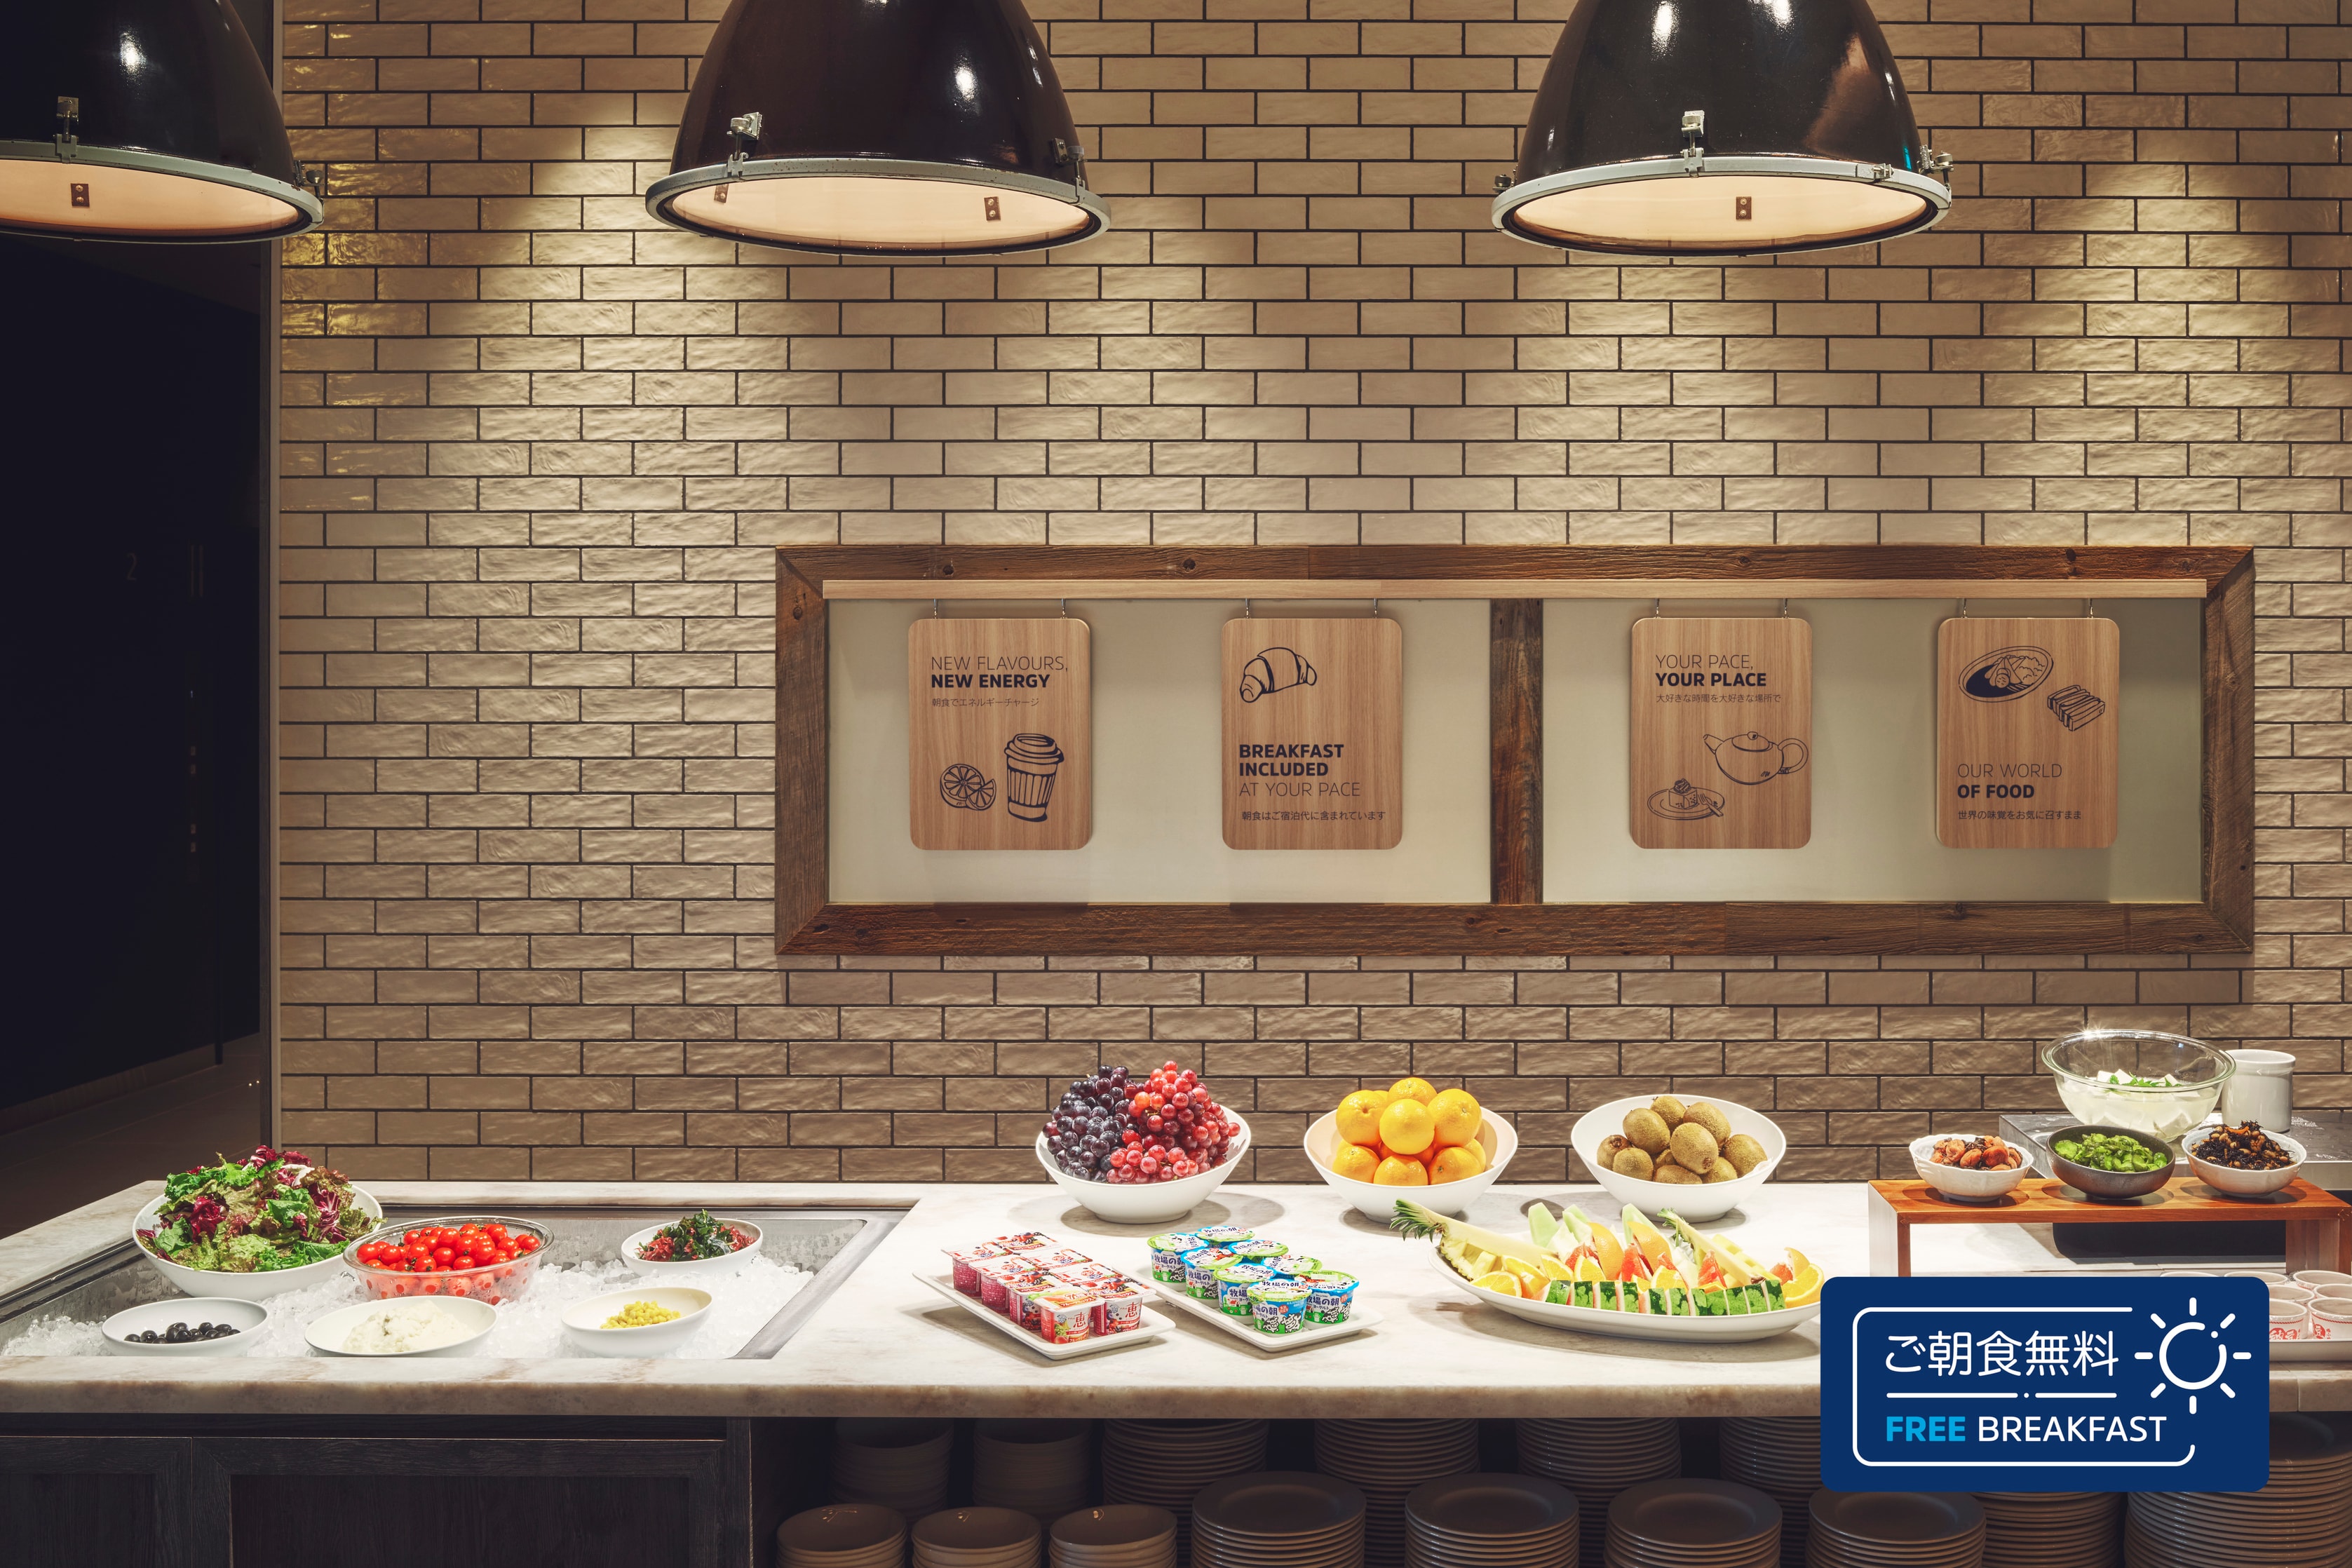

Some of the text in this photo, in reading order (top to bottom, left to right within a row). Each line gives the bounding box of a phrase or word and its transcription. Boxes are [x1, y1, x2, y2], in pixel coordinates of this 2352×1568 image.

[931, 656, 1068, 672] NEW FLAVOURS,
[1655, 654, 1753, 670] YOUR PACE,
[931, 674, 1050, 688] NEW ENERGY
[1655, 673, 1766, 687] YOUR PLACE
[932, 698, 1039, 708] 朝食でエネルギーチャージ
[1656, 694, 1781, 703] 大好きな時間を大好きな場所で
[1239, 744, 1344, 758] BREAKFAST
[1239, 762, 1329, 776] INCLUDED
[1957, 763, 2062, 778] OUR WORLD
[1239, 782, 1360, 797] AT YOUR PACE
[1957, 784, 2034, 798] OF FOOD
[1242, 811, 1386, 821] 朝食はご宿泊代に含まれています
[1958, 810, 2081, 820] 世界の味覚をお気に召すまま
[1188, 1270, 1215, 1281] 牧場の
[1229, 1288, 1247, 1297] 牧場
[1252, 1304, 1278, 1316] 場の朝
